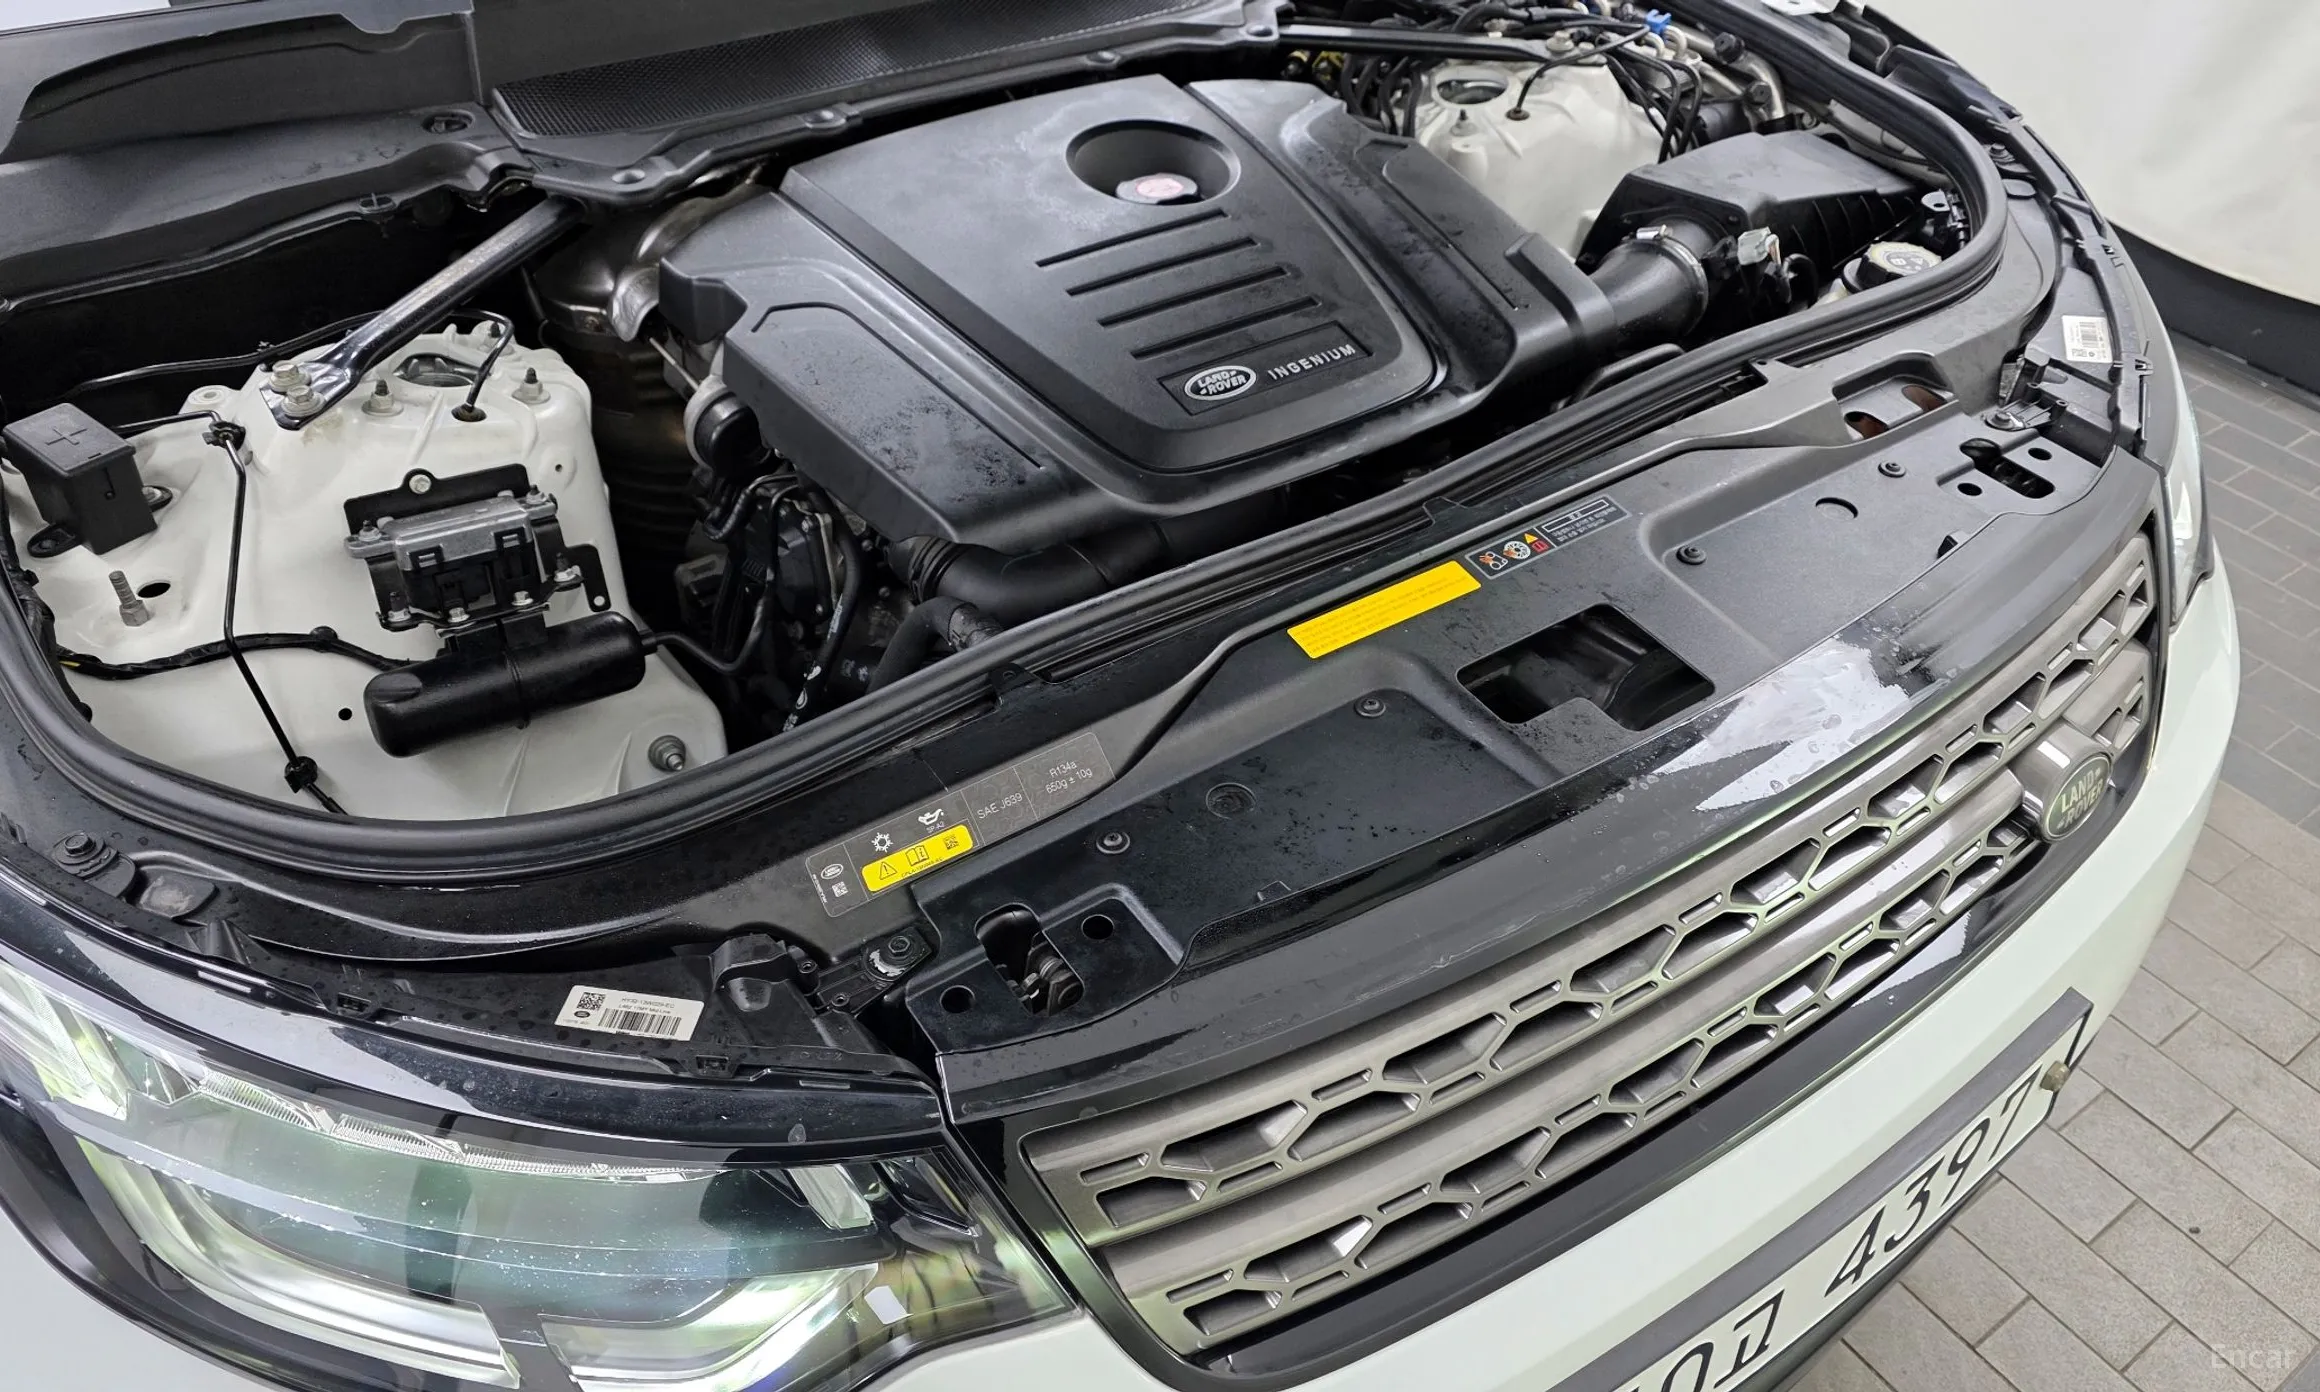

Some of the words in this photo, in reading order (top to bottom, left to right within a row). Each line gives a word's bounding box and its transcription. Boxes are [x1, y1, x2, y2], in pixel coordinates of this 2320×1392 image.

[1267, 343, 1356, 381] INGENIUM
[1197, 370, 1230, 388] LAND
[1206, 374, 1247, 395] ROVER
[1045, 779, 1068, 794] 650g
[1075, 768, 1093, 780] 10g
[1048, 761, 1078, 778] R134a
[2061, 769, 2095, 813] LAND
[2064, 778, 2104, 829] ROVER
[976, 802, 1000, 819] SAE
[1000, 792, 1023, 810] J639
[1823, 1063, 2043, 1298] 4397
